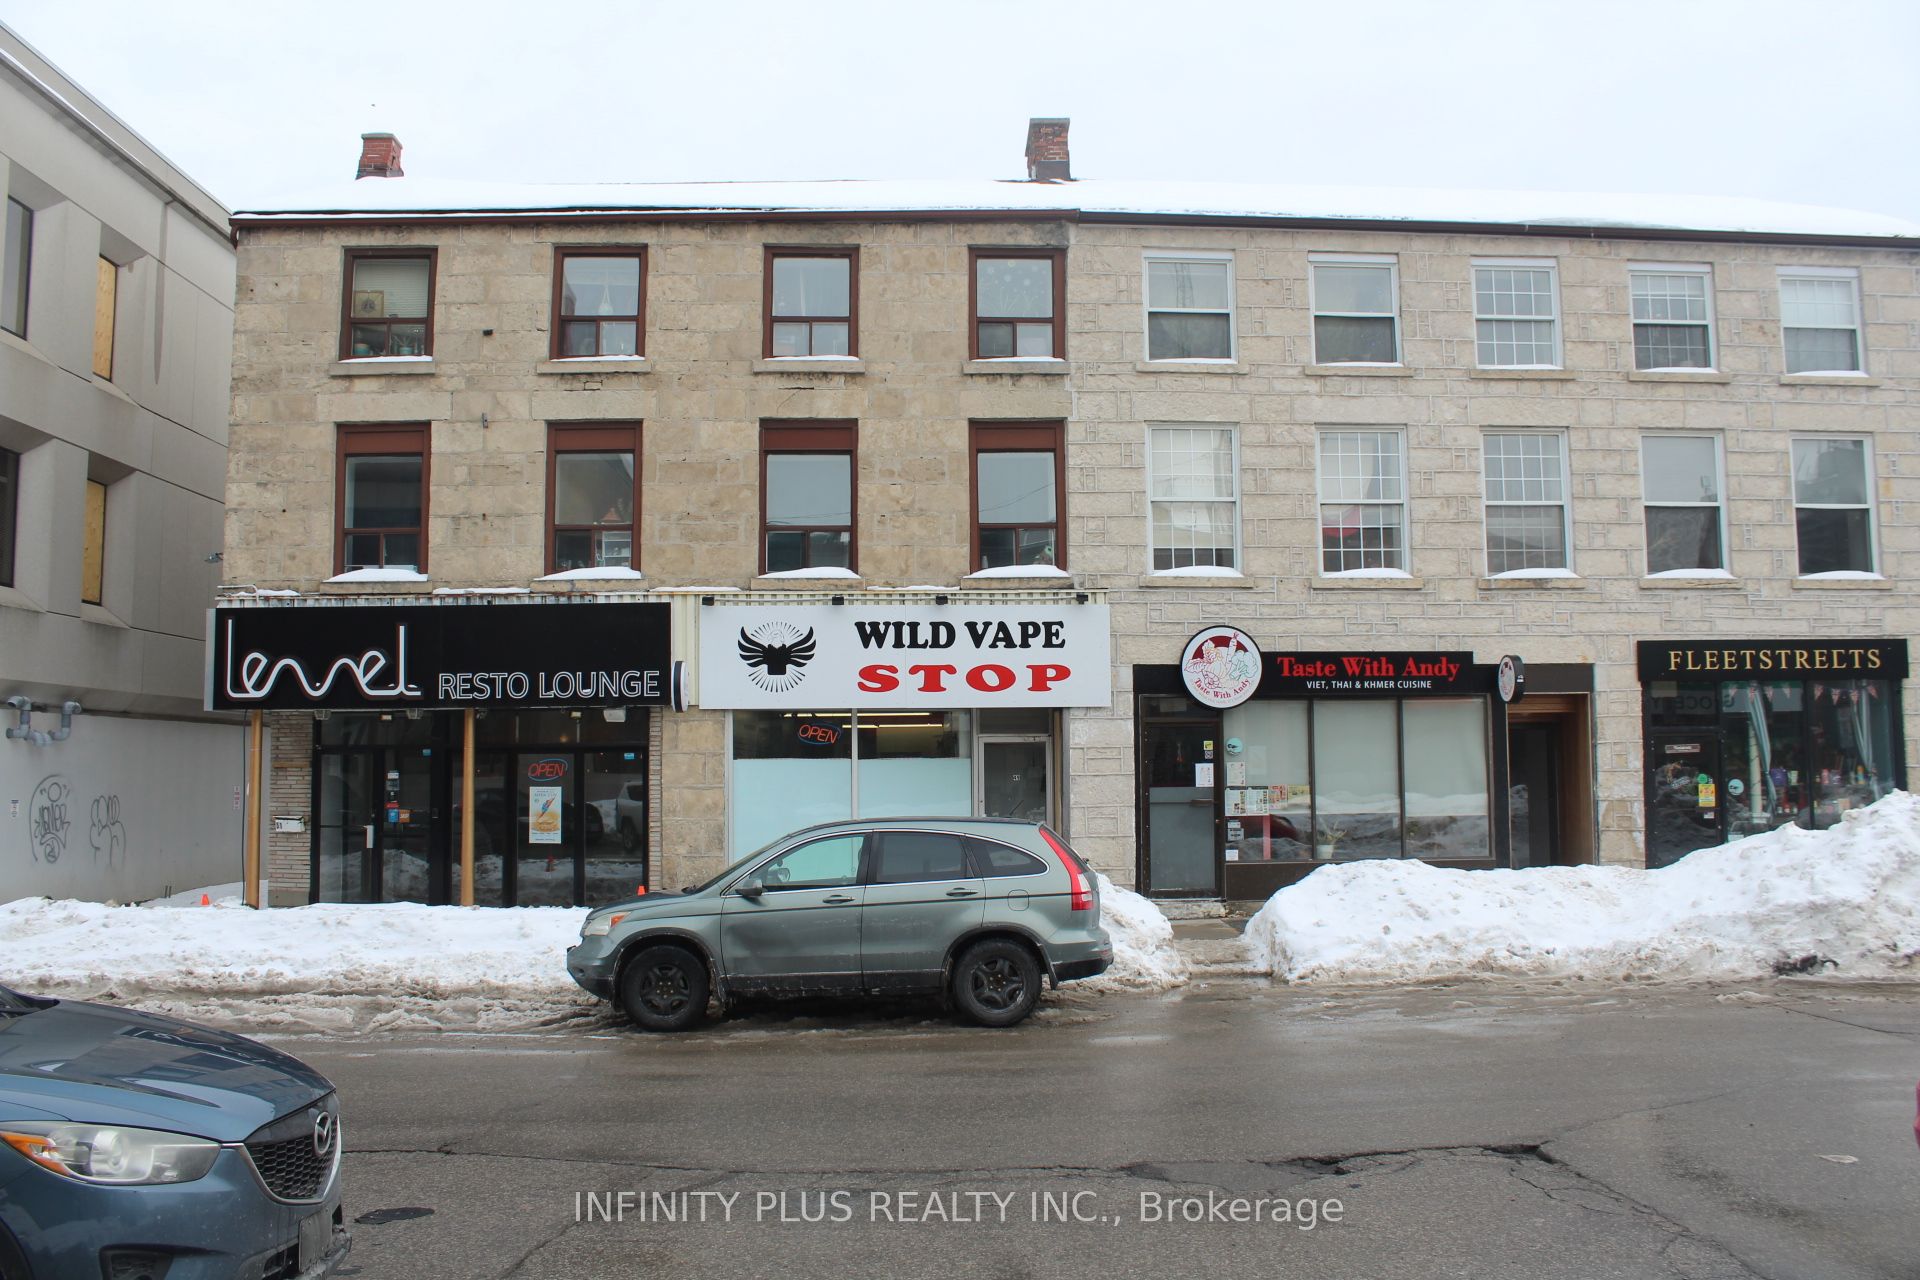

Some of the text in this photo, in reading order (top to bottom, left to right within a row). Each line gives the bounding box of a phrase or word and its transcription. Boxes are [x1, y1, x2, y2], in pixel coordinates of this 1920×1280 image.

[854, 620, 1066, 649] WILD VAPE
[857, 664, 1071, 693] STOP
[1277, 656, 1460, 681] Taste With Andy
[438, 670, 660, 700] RESTO LOUNGE
[1194, 677, 1251, 699] Taste With Andy
[1306, 680, 1432, 690] VIET, THAI & KHMER CUISINE
[799, 724, 838, 744] OPEN
[528, 763, 565, 777] OPEN
